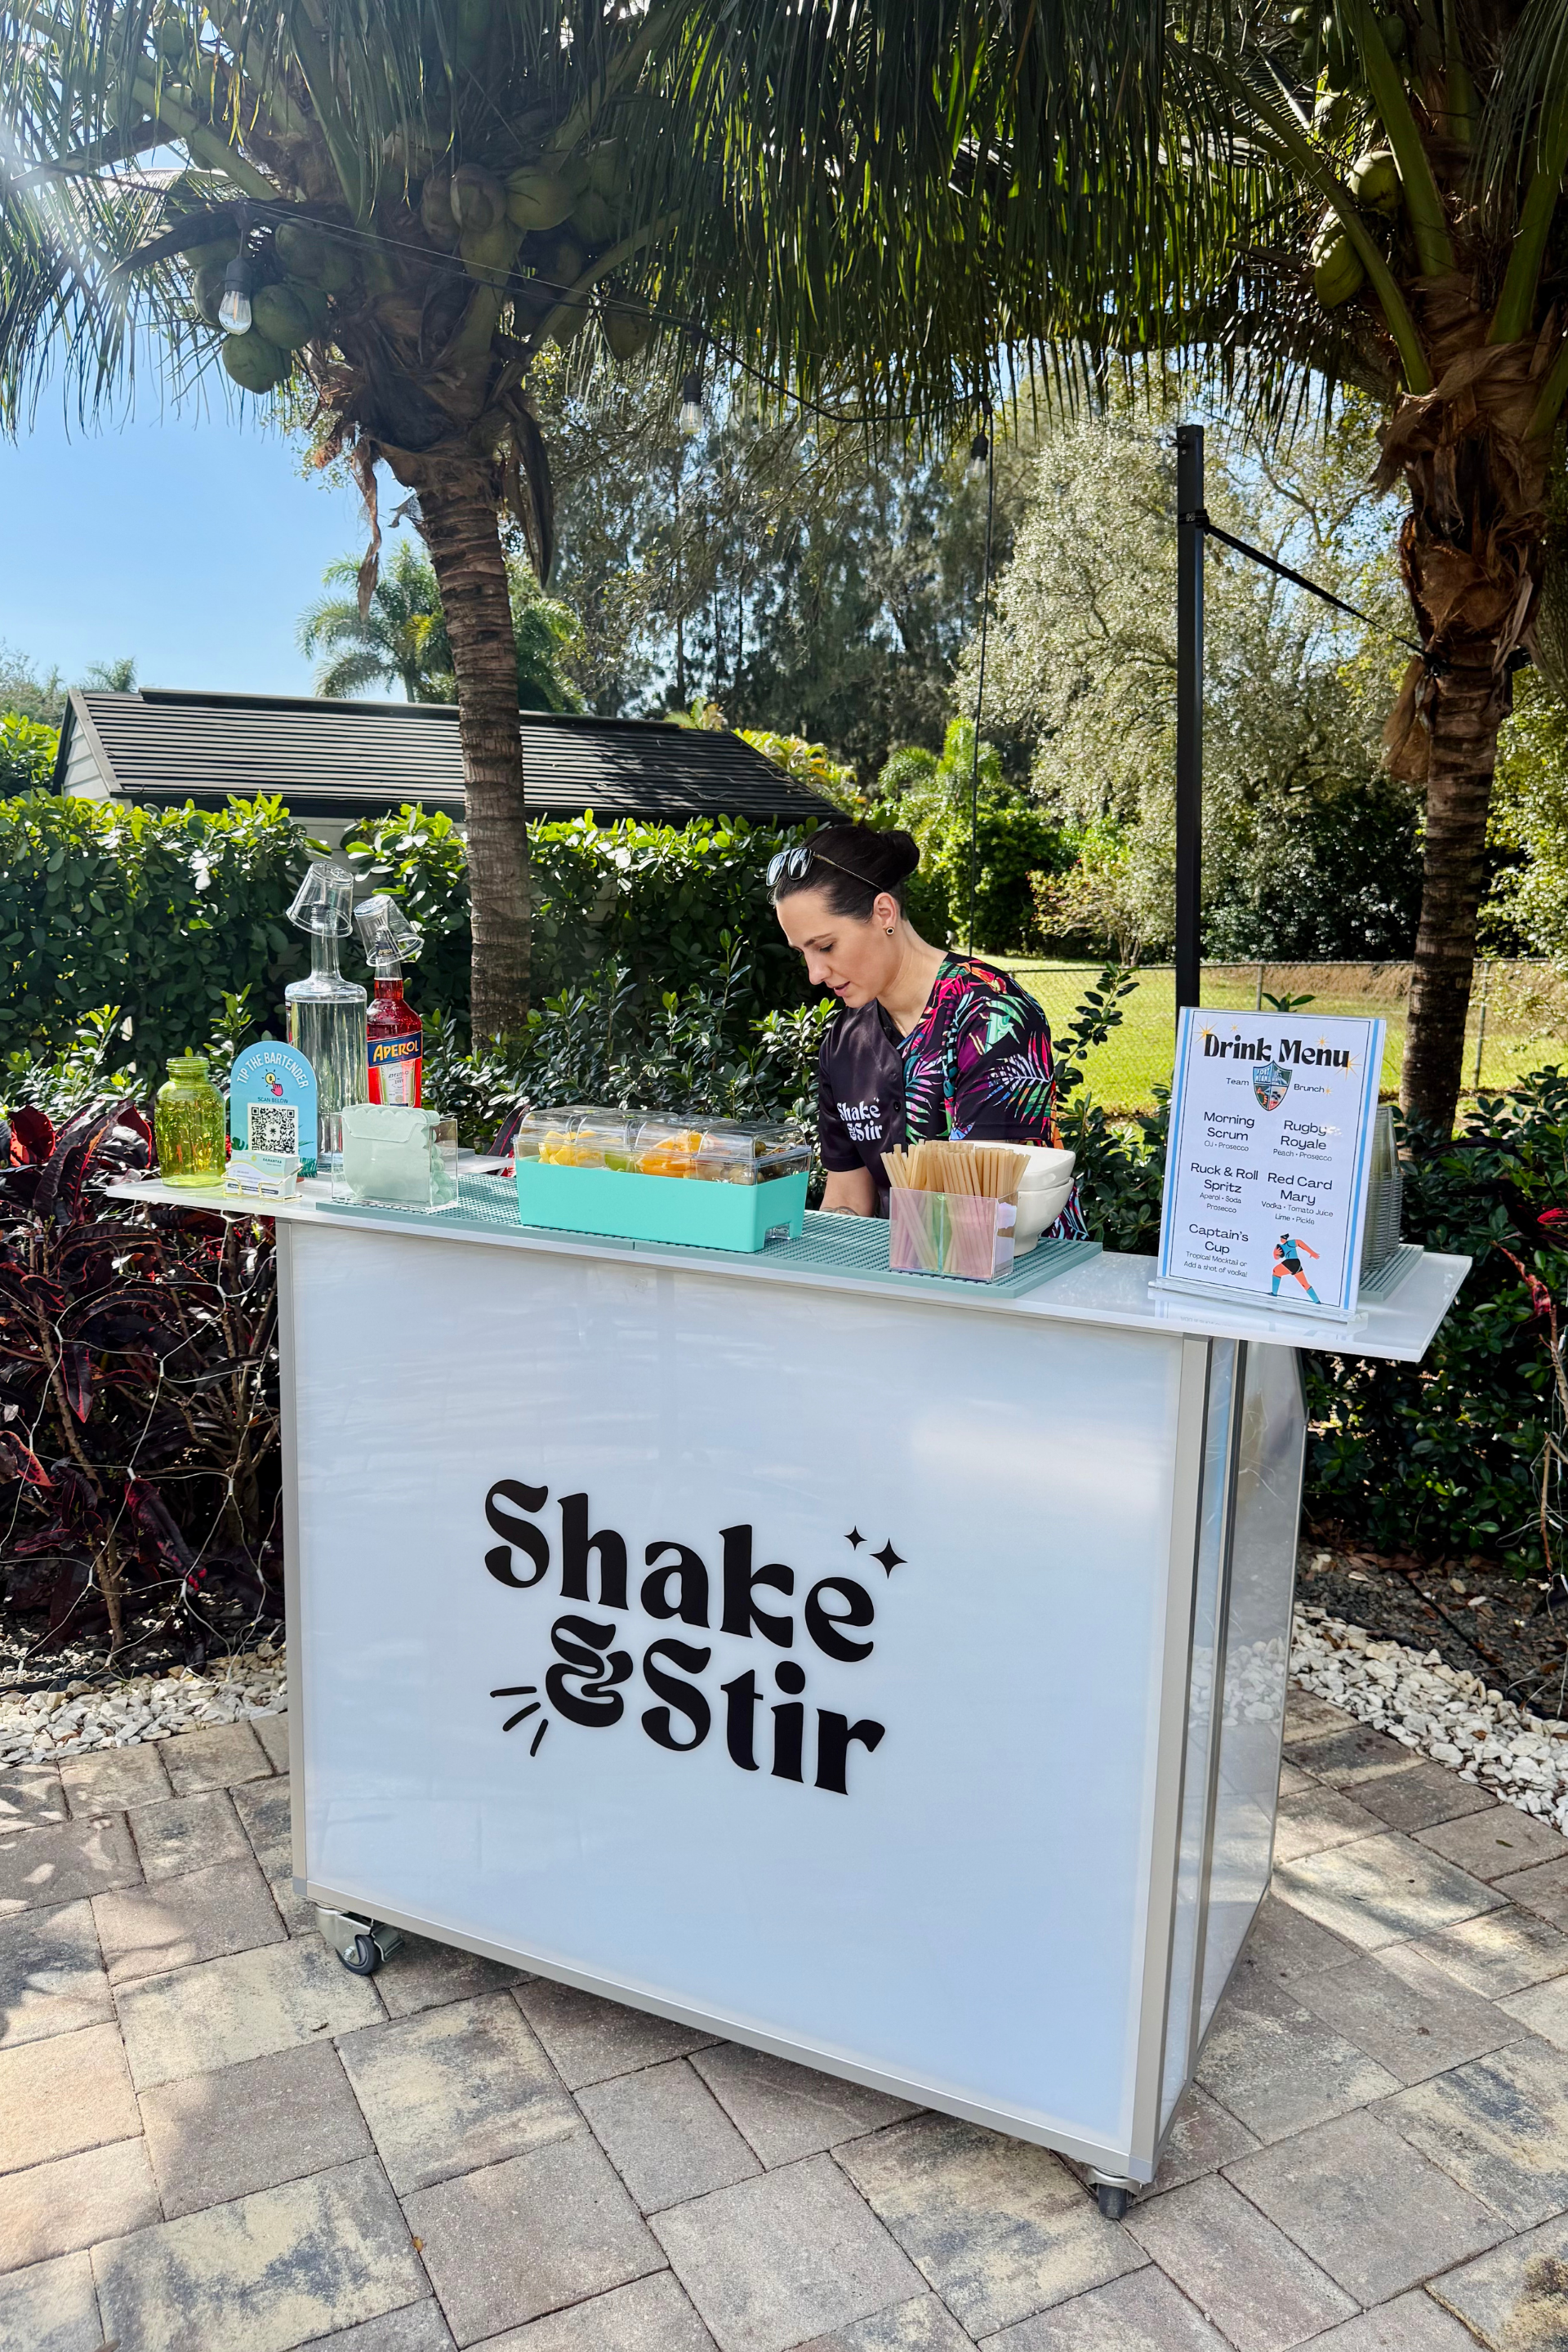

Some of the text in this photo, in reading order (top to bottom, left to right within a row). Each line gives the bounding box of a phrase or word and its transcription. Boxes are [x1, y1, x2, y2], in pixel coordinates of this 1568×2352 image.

[372, 1040, 419, 1062] APEROL
[1204, 1034, 1350, 1067] Drink Menu
[236, 1052, 310, 1089] TIP THE BARTENDER
[1226, 1078, 1250, 1086] Team
[1294, 1084, 1325, 1094] Brunch
[837, 1101, 881, 1121] Shake
[1204, 1111, 1255, 1129] Morning
[1284, 1120, 1327, 1136] Rugby
[1207, 1127, 1249, 1141] Scrum
[1218, 1142, 1249, 1152] Prosecco
[1281, 1135, 1327, 1150] Royale
[1273, 1148, 1332, 1161] Peach Prosecco
[1191, 1162, 1258, 1180] Ruck & Roll
[1204, 1179, 1242, 1193] Spritz
[1267, 1173, 1333, 1190] Red Card
[1200, 1192, 1242, 1204] Aperol Soda
[1281, 1189, 1316, 1206] Mary
[1206, 1203, 1236, 1214] Prosecco
[1261, 1200, 1334, 1217] Vodka Tomato Juice
[1296, 1216, 1315, 1225] Pickle
[1189, 1223, 1249, 1241] Captain's
[1205, 1241, 1230, 1255] Cup
[1186, 1250, 1211, 1260] Tropical
[1212, 1255, 1239, 1266] Mocktail
[1184, 1260, 1196, 1268] Add
[1227, 1269, 1248, 1277] vodka!
[485, 1479, 875, 1662] Shake
